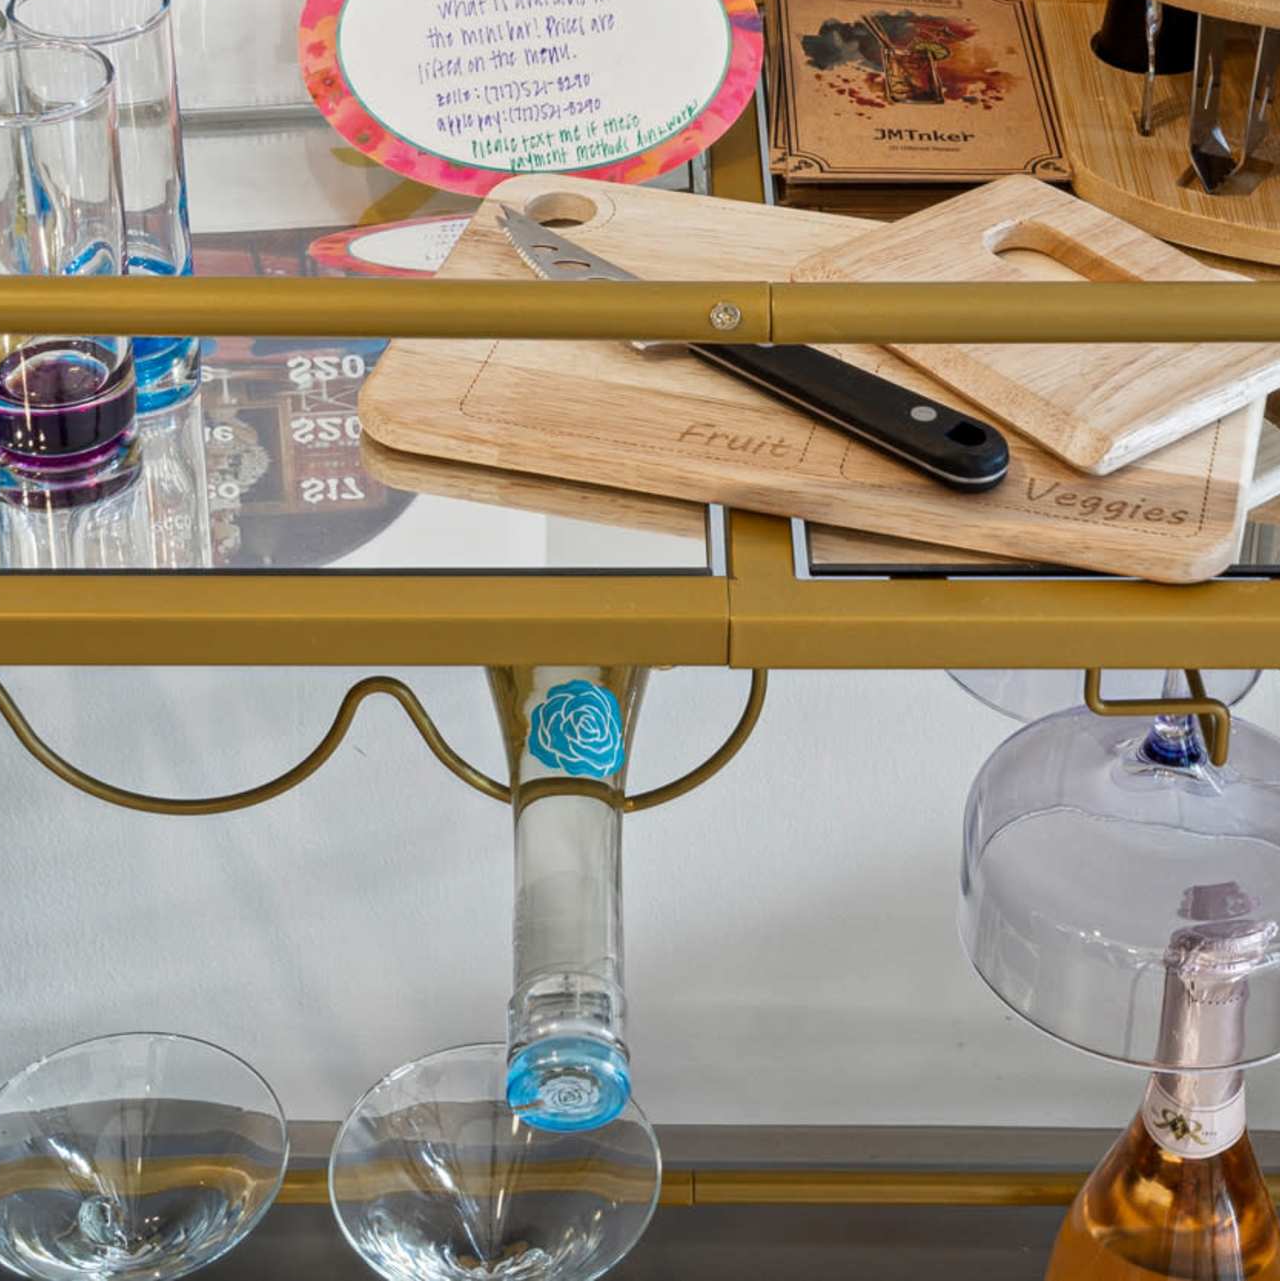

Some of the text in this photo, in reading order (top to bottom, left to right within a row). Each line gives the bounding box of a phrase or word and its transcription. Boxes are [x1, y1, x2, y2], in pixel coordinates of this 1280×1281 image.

[426, 25, 453, 49] the
[591, 13, 615, 34] are
[417, 55, 463, 85] listed
[468, 56, 486, 74] on
[489, 49, 517, 69] the
[521, 131, 553, 151] text
[559, 123, 581, 144] me
[586, 119, 597, 135] if
[678, 422, 793, 459] Fruit
[1025, 477, 1190, 526] Veggies
